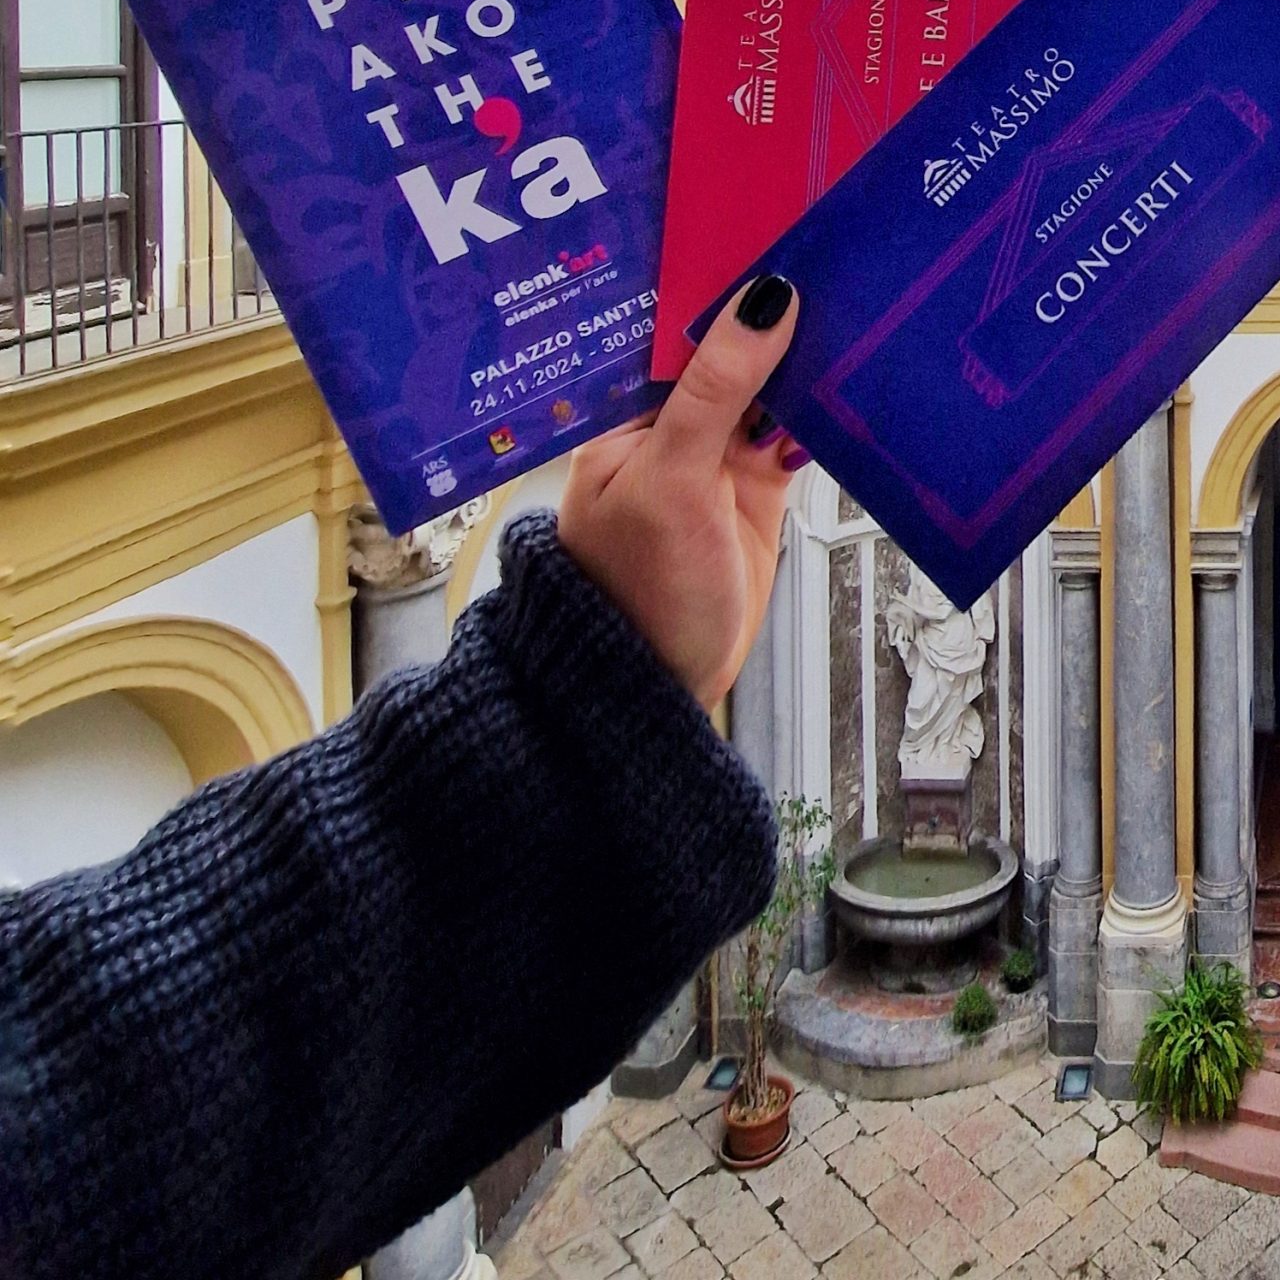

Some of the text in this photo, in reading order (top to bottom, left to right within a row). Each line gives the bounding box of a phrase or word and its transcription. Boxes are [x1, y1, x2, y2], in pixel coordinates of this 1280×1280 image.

[366, 49, 552, 149] THE
[921, 53, 945, 67] E
[952, 47, 1059, 154] TEATRO
[965, 59, 1075, 171] MASSIMO
[395, 134, 609, 265] ka
[1035, 162, 1114, 243] STAGIONE
[1035, 160, 1194, 324] CONCERTI
[505, 269, 618, 327] elenka per l'arte
[470, 331, 573, 388] PALAZZO
[470, 352, 583, 417] 24.11.2024
[422, 456, 448, 479] ARS
